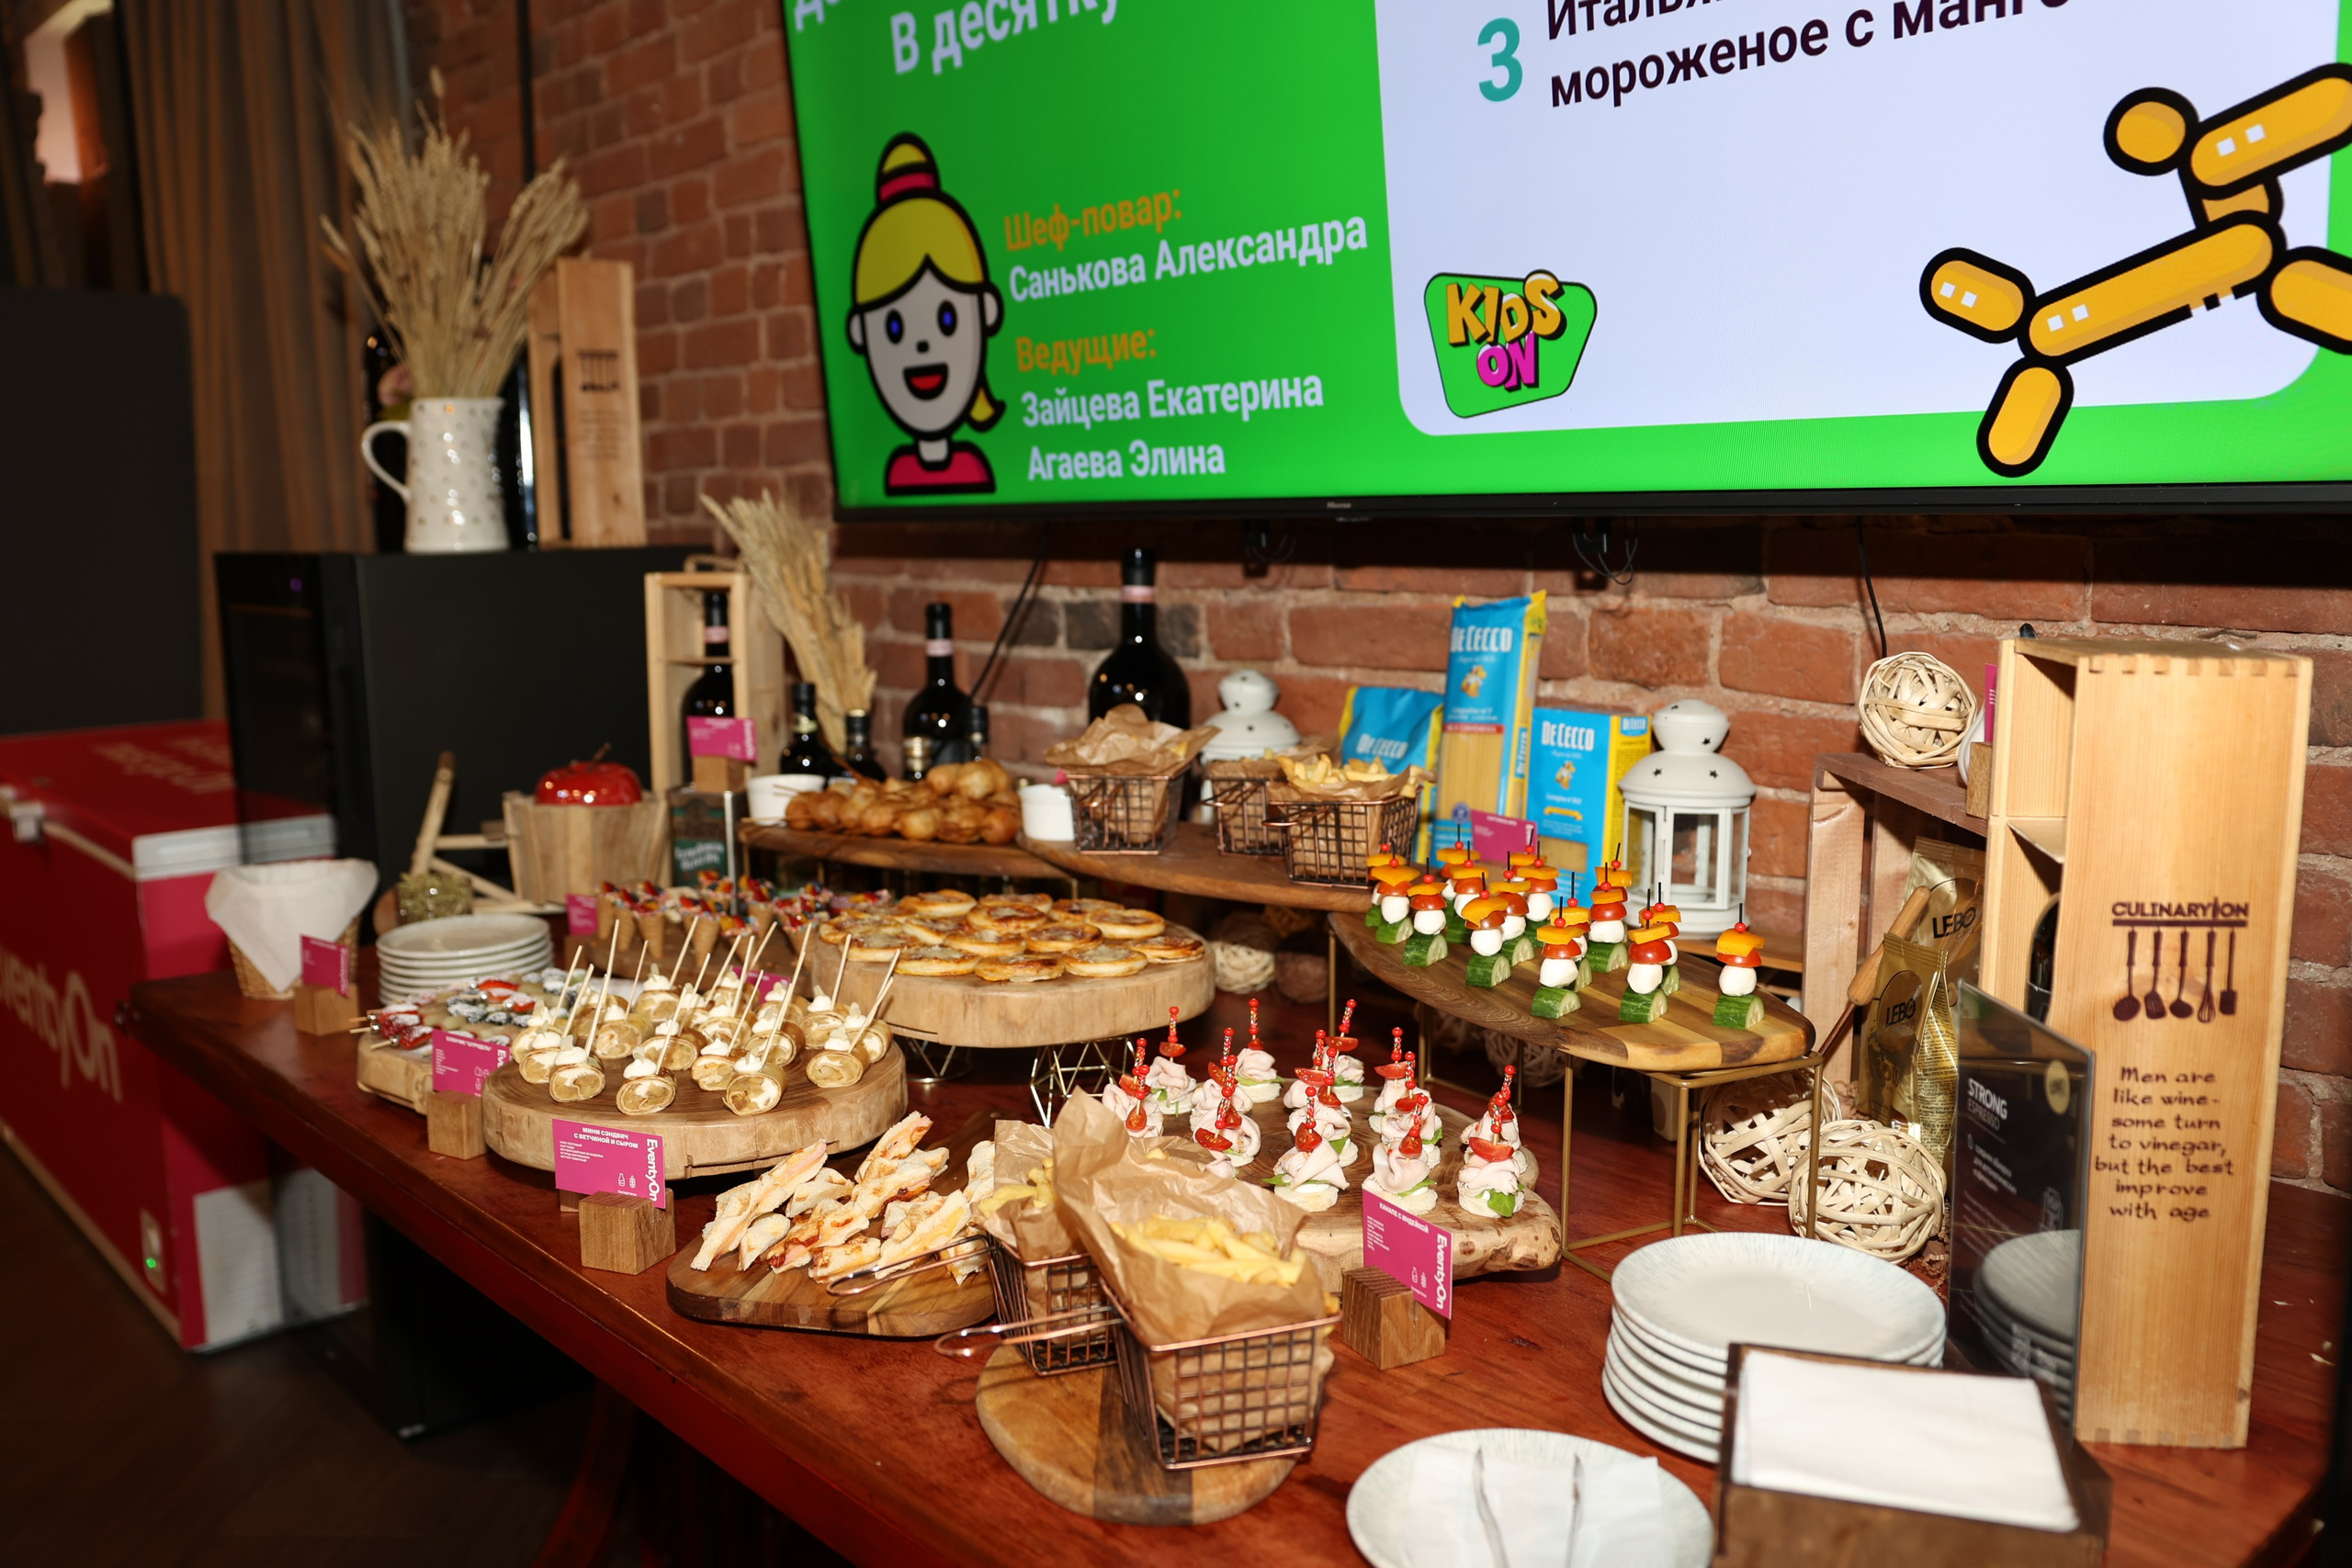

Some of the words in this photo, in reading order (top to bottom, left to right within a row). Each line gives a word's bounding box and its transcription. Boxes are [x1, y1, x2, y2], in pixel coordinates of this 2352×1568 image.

[890, 11, 920, 74] В
[1477, 17, 1523, 103] 3
[1549, 18, 1830, 107] мороженое
[1846, 8, 1874, 47] с
[1003, 188, 1182, 252] Шеф-повар:
[1009, 251, 1148, 302] Санькова
[1154, 216, 1368, 279] Александра
[1446, 270, 1566, 346] KIDS
[1015, 328, 1157, 377] Ведущие:
[1476, 330, 1539, 391] ON
[1021, 386, 1141, 430] Зайцева
[1147, 373, 1324, 422] Екатерина
[1028, 446, 1124, 481] Агаева
[1129, 439, 1226, 477] Элина
[1932, 907, 1977, 939] LEBO
[1885, 998, 1917, 1027] LEBO
[2120, 1066, 2167, 1083] Men
[2175, 1072, 2216, 1083] are
[1968, 1077, 2007, 1121] STRONG
[2113, 1088, 2154, 1106] like
[579, 1134, 610, 1145] ВЕТЧИНОЙ
[616, 1139, 639, 1149] СЫРОМ
[582, 1127, 601, 1135] МИНИ
[601, 1129, 629, 1140] СЭНДВИЧ
[2111, 1117, 2165, 1129] some
[2175, 1114, 2222, 1130] turn
[2095, 1156, 2130, 1175] but
[2138, 1157, 2173, 1176] the
[2186, 1157, 2234, 1176] best
[2109, 1133, 2132, 1150] to
[2139, 1136, 2227, 1157] vinegar,
[645, 1138, 660, 1201] EventyOn
[2116, 1179, 2208, 1199] improve
[2109, 1201, 2157, 1220] with
[2169, 1207, 2211, 1223] age
[1434, 1234, 1448, 1310] EventyOn
